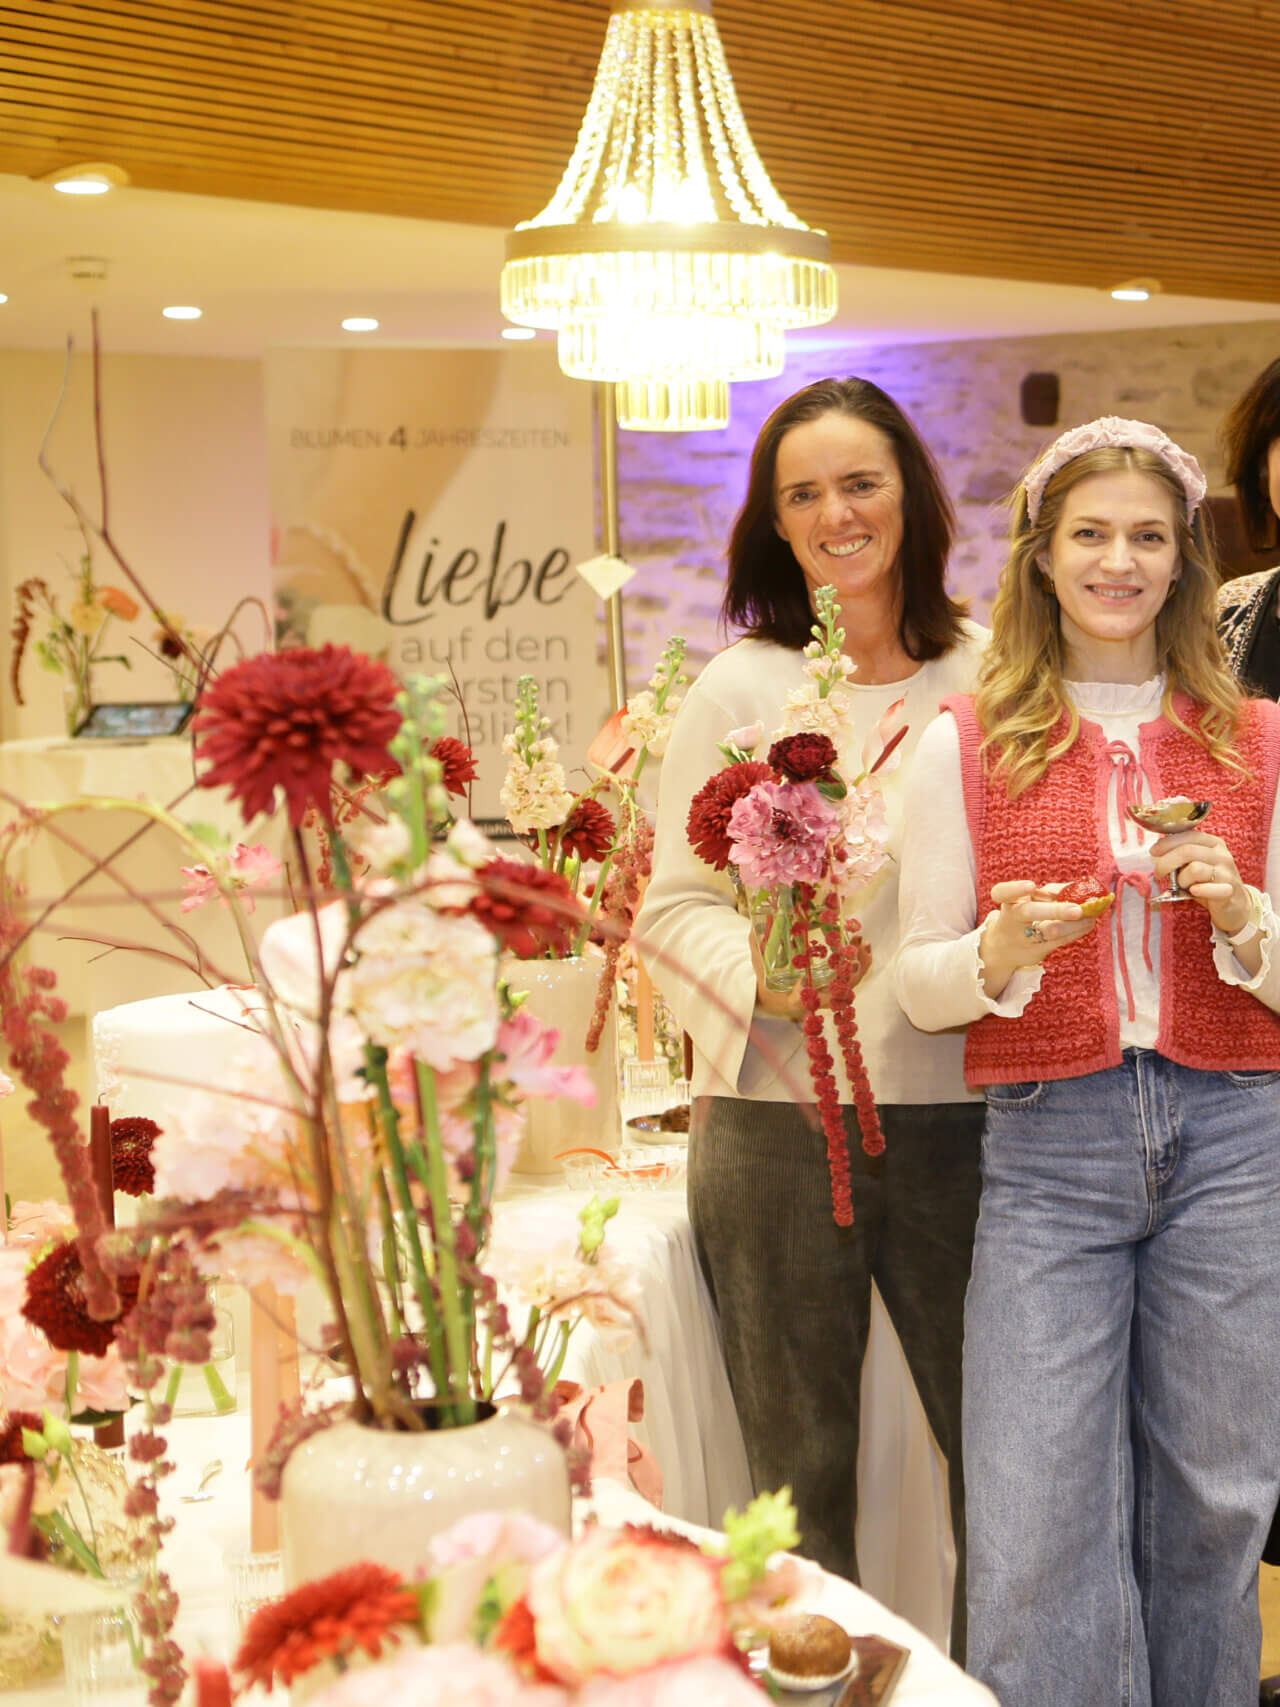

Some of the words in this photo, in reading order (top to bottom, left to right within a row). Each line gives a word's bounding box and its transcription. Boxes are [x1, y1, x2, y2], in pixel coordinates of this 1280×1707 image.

[290, 427, 382, 449] BLUMEN
[388, 425, 408, 451] 4
[414, 427, 568, 449] JAHRESZEITEN
[382, 509, 577, 626] Liebe
[400, 627, 472, 664] auf
[484, 627, 569, 663] den
[432, 675, 570, 705] rstn
[457, 712, 572, 746] Blik!
